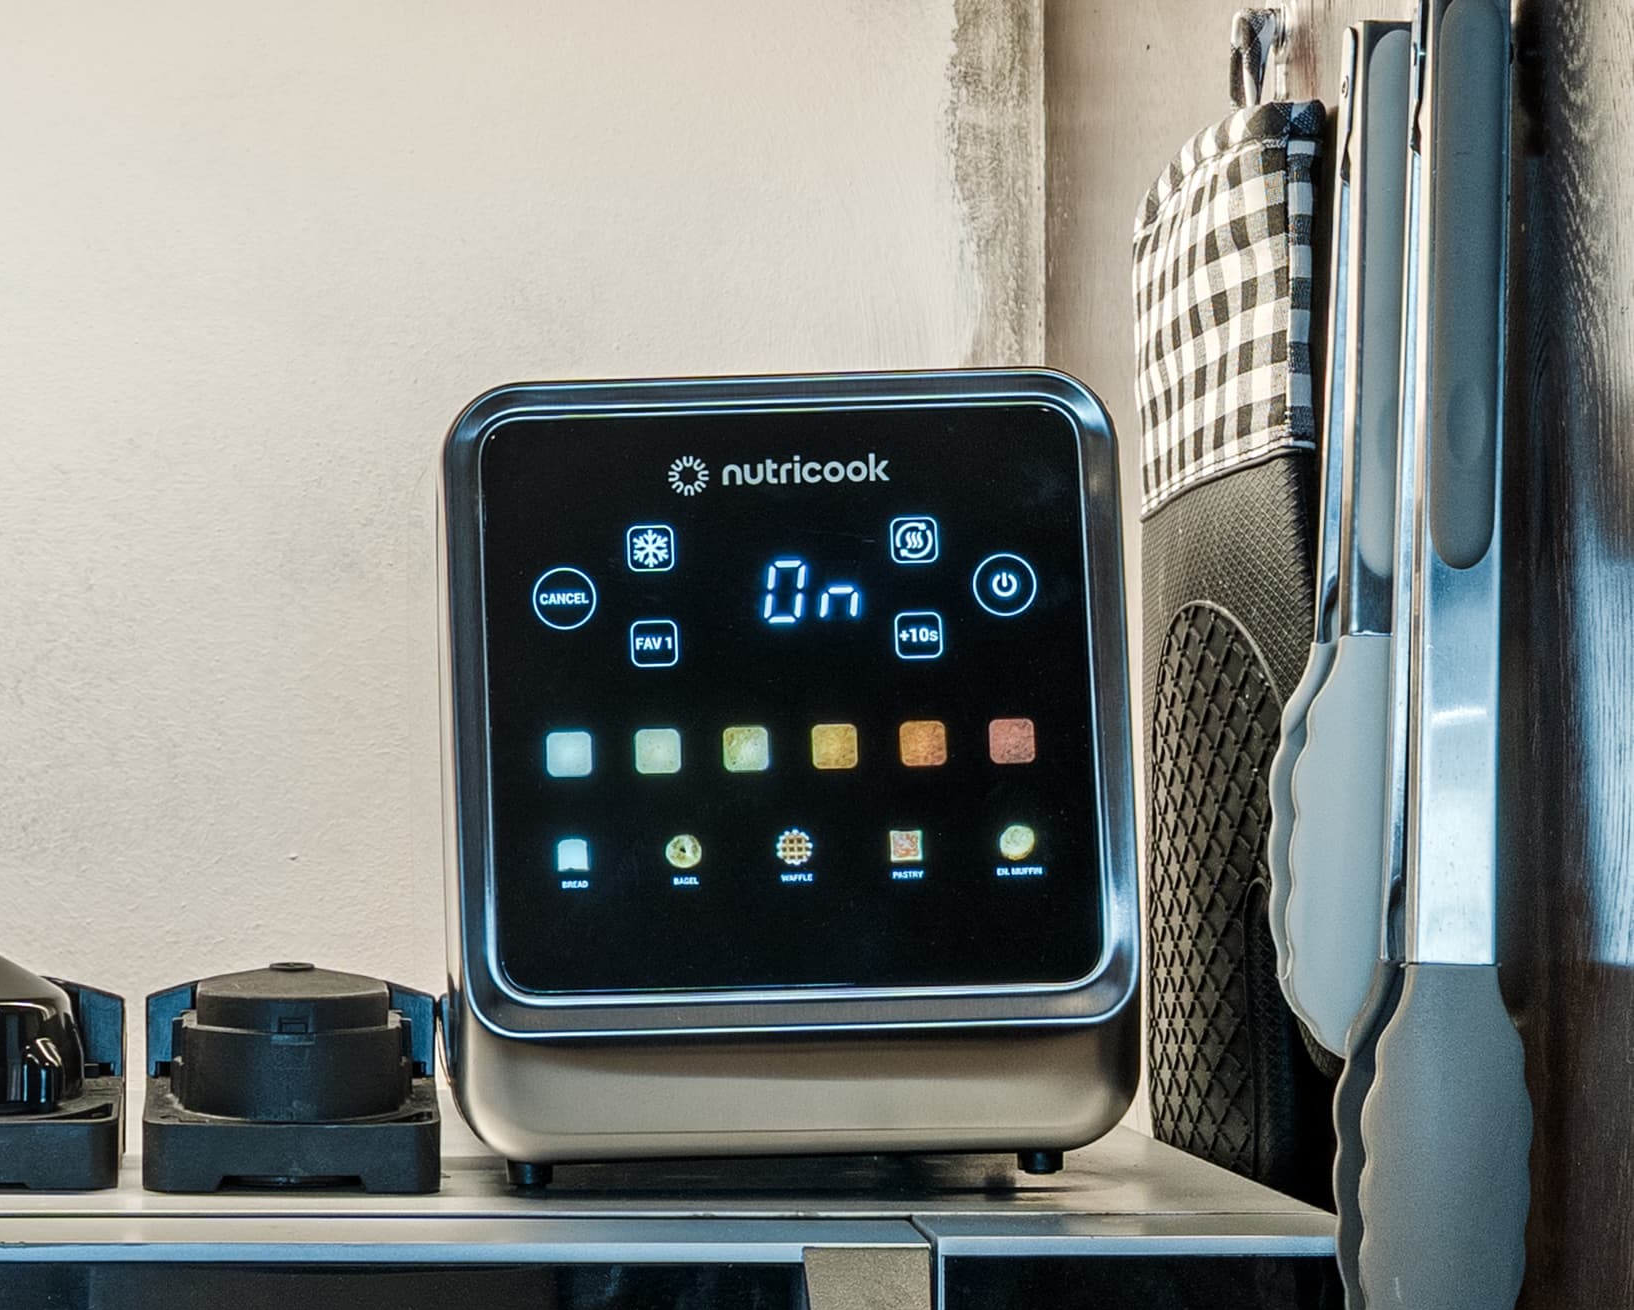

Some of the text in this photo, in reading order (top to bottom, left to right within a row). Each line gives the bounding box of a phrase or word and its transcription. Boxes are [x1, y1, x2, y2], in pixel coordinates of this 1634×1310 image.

[722, 452, 890, 486] nutricook
[538, 591, 590, 606] CANCEL
[898, 626, 940, 644] +10s
[634, 635, 674, 652] FAV 1
[672, 875, 700, 886] BAGEL
[780, 872, 814, 883] WAFFLE
[891, 869, 925, 880] PASTRY
[561, 879, 590, 889] BREAD
